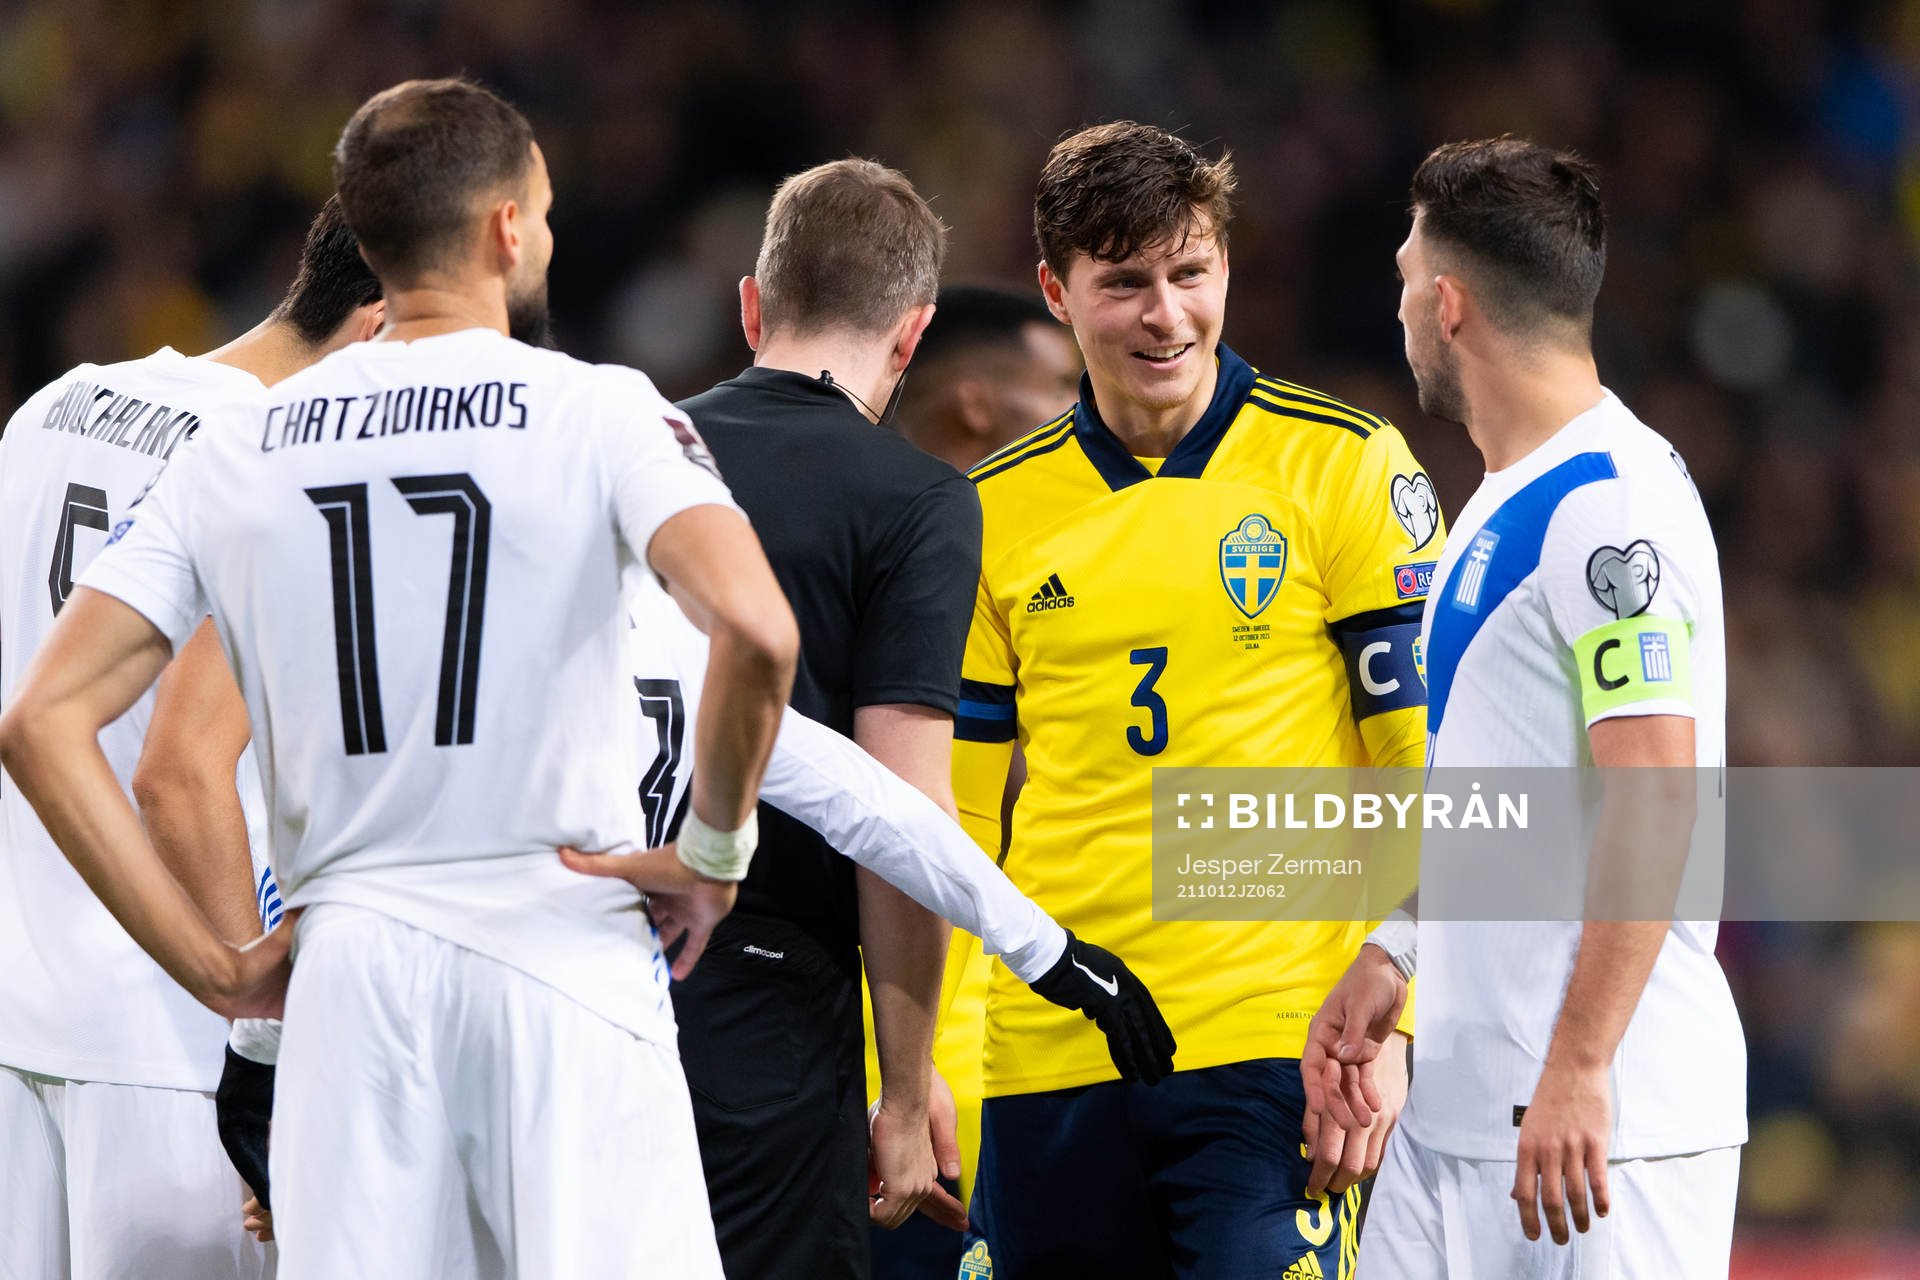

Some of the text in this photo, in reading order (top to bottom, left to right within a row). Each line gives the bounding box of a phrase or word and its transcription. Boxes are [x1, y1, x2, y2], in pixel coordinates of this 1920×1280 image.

[260, 381, 528, 453] CHATZIDIAKOS
[1231, 545, 1275, 553] SVERIGE
[303, 473, 492, 756] 17
[1026, 596, 1075, 613] adidas
[1359, 641, 1400, 696] C
[1593, 638, 1630, 691] C
[1127, 646, 1168, 756] 3
